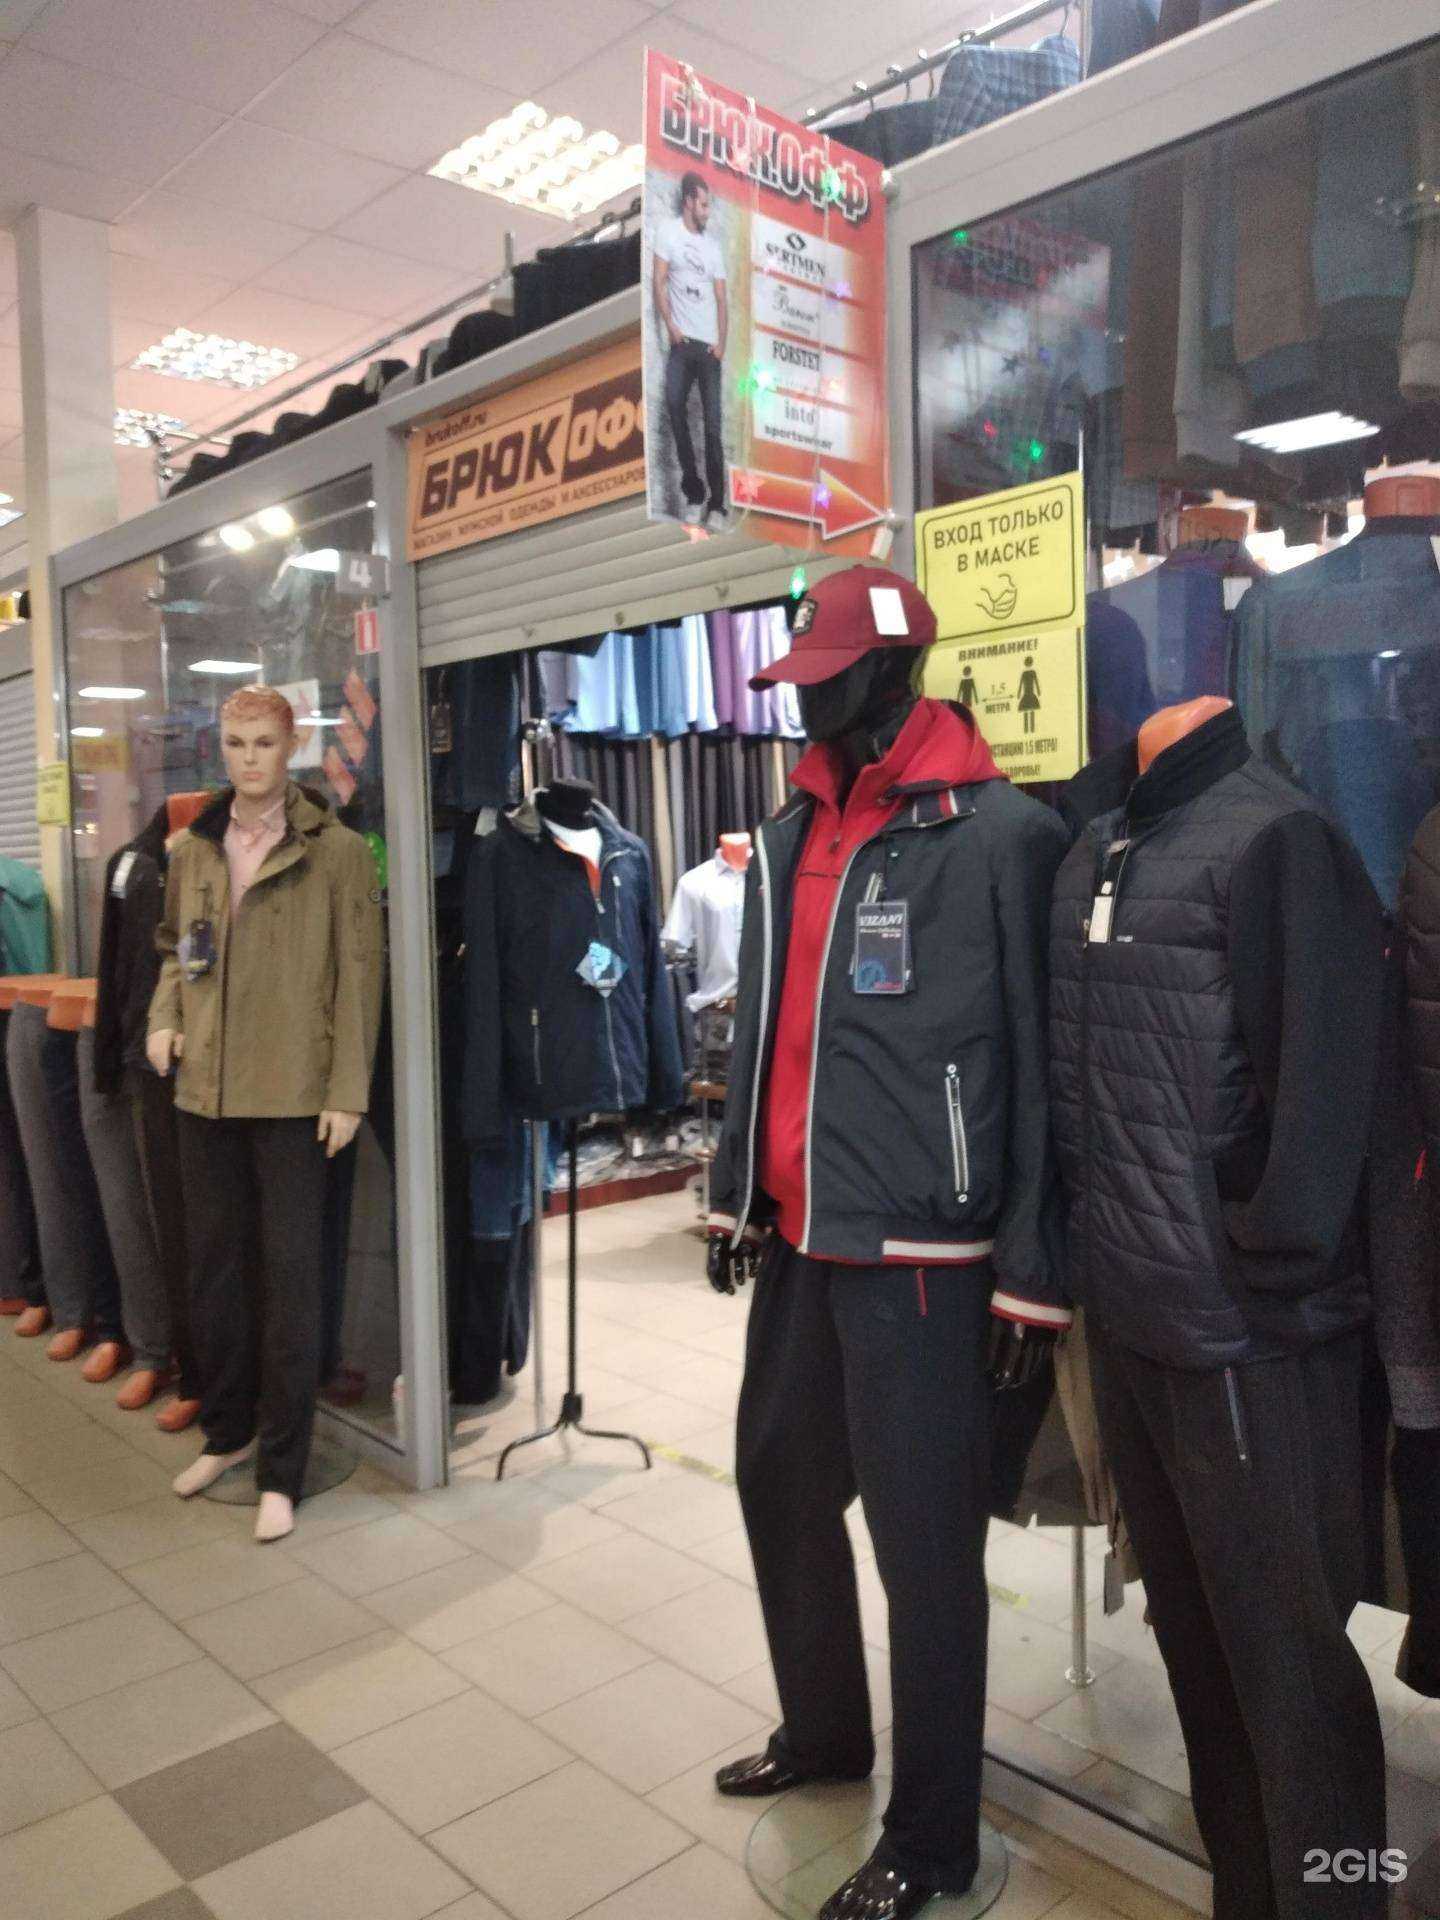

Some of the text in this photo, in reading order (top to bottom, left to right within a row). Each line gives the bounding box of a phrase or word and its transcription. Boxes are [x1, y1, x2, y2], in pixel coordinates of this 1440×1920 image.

[420, 396, 645, 519] БРЮКОФ
[933, 500, 1063, 550] ВХОД ТОЛЬКО
[957, 536, 1040, 573] В МАСКЕ
[349, 559, 373, 589] 4
[958, 638, 1039, 662] ВНИМАНИЕ!
